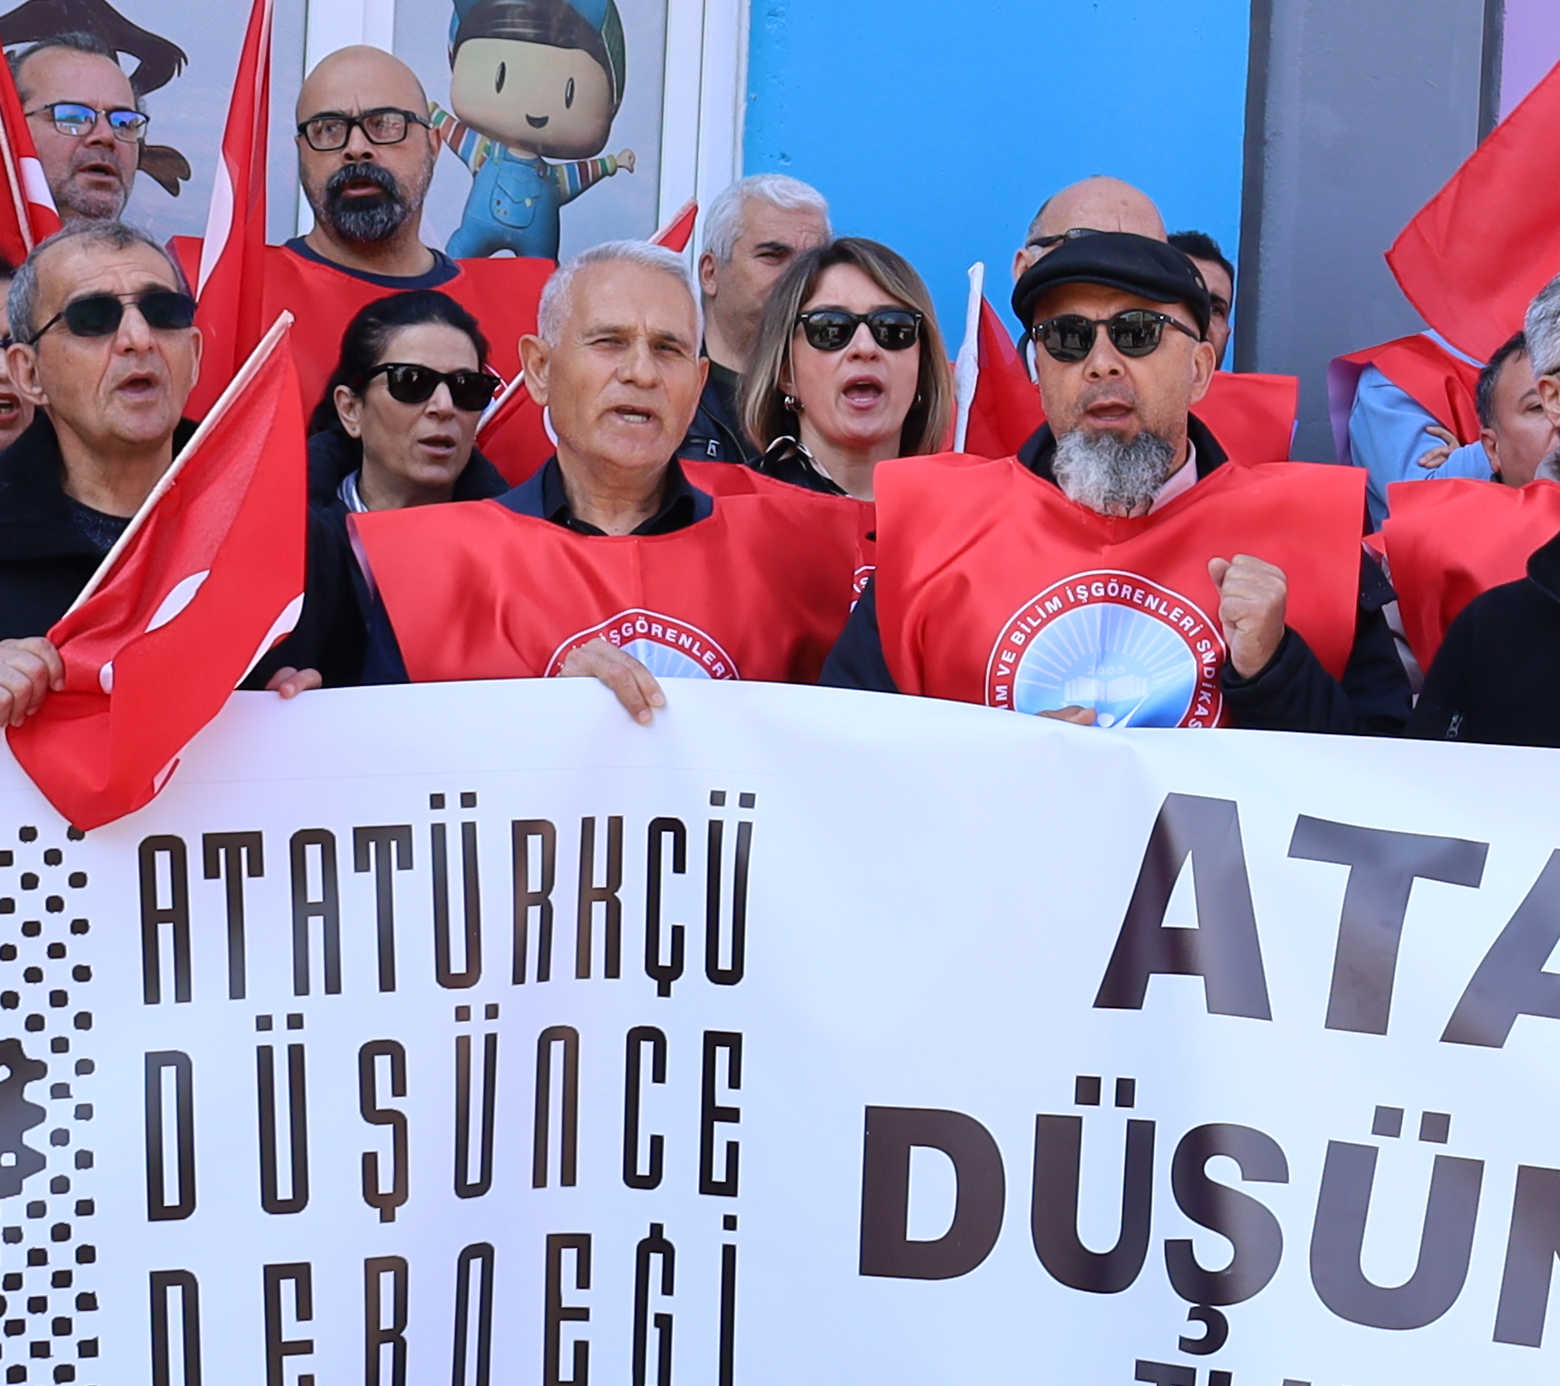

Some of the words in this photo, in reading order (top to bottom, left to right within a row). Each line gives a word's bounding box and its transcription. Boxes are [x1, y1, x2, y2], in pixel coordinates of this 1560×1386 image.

[996, 649, 1017, 676] VE
[1010, 595, 1064, 646] BİLİM
[1065, 578, 1205, 637] İŞGÖRENLERİ
[138, 790, 755, 1005] ATATÜRKÇÜ
[145, 1003, 743, 1223] DÜŞÜNCE
